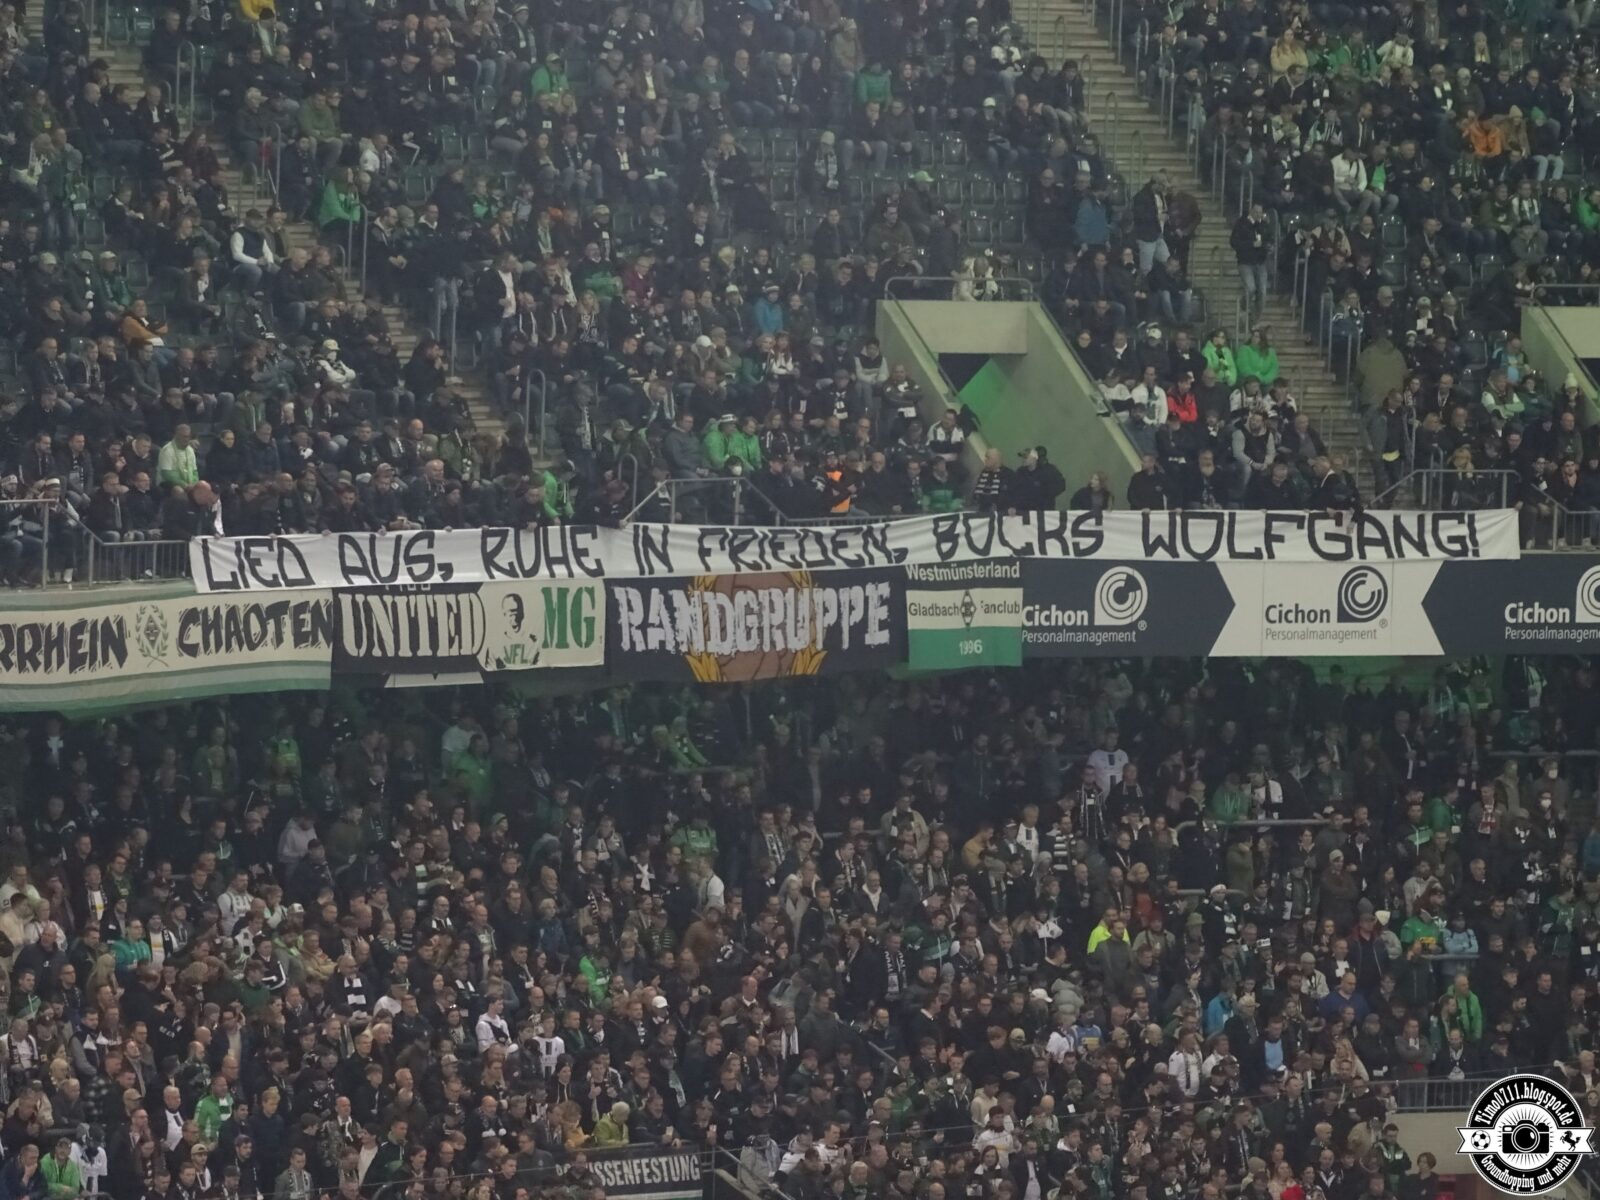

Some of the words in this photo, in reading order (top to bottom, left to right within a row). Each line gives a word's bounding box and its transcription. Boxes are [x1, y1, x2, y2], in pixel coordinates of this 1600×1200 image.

[202, 537, 315, 592] LIED
[338, 530, 454, 585] AUS,
[481, 525, 605, 580] RUHE
[633, 524, 674, 577] IN
[698, 523, 909, 573] FRIEDEN,
[1141, 508, 1480, 561] WOLFGANG!
[905, 561, 1021, 581] Westmünsterland
[541, 587, 597, 650] MG
[613, 581, 892, 657] RANDGRUPPE
[908, 602, 960, 617] Gladbach
[980, 600, 1021, 615] anclub
[1022, 604, 1089, 627] Cichon
[1265, 603, 1331, 624] Cichon
[1504, 601, 1570, 624] Cichon
[177, 599, 333, 658] CHAOTEN
[338, 592, 486, 657] UNITED
[1264, 627, 1377, 643] Personalmanagement
[959, 639, 983, 656] 1996
[1021, 628, 1137, 646] Personalmanagement
